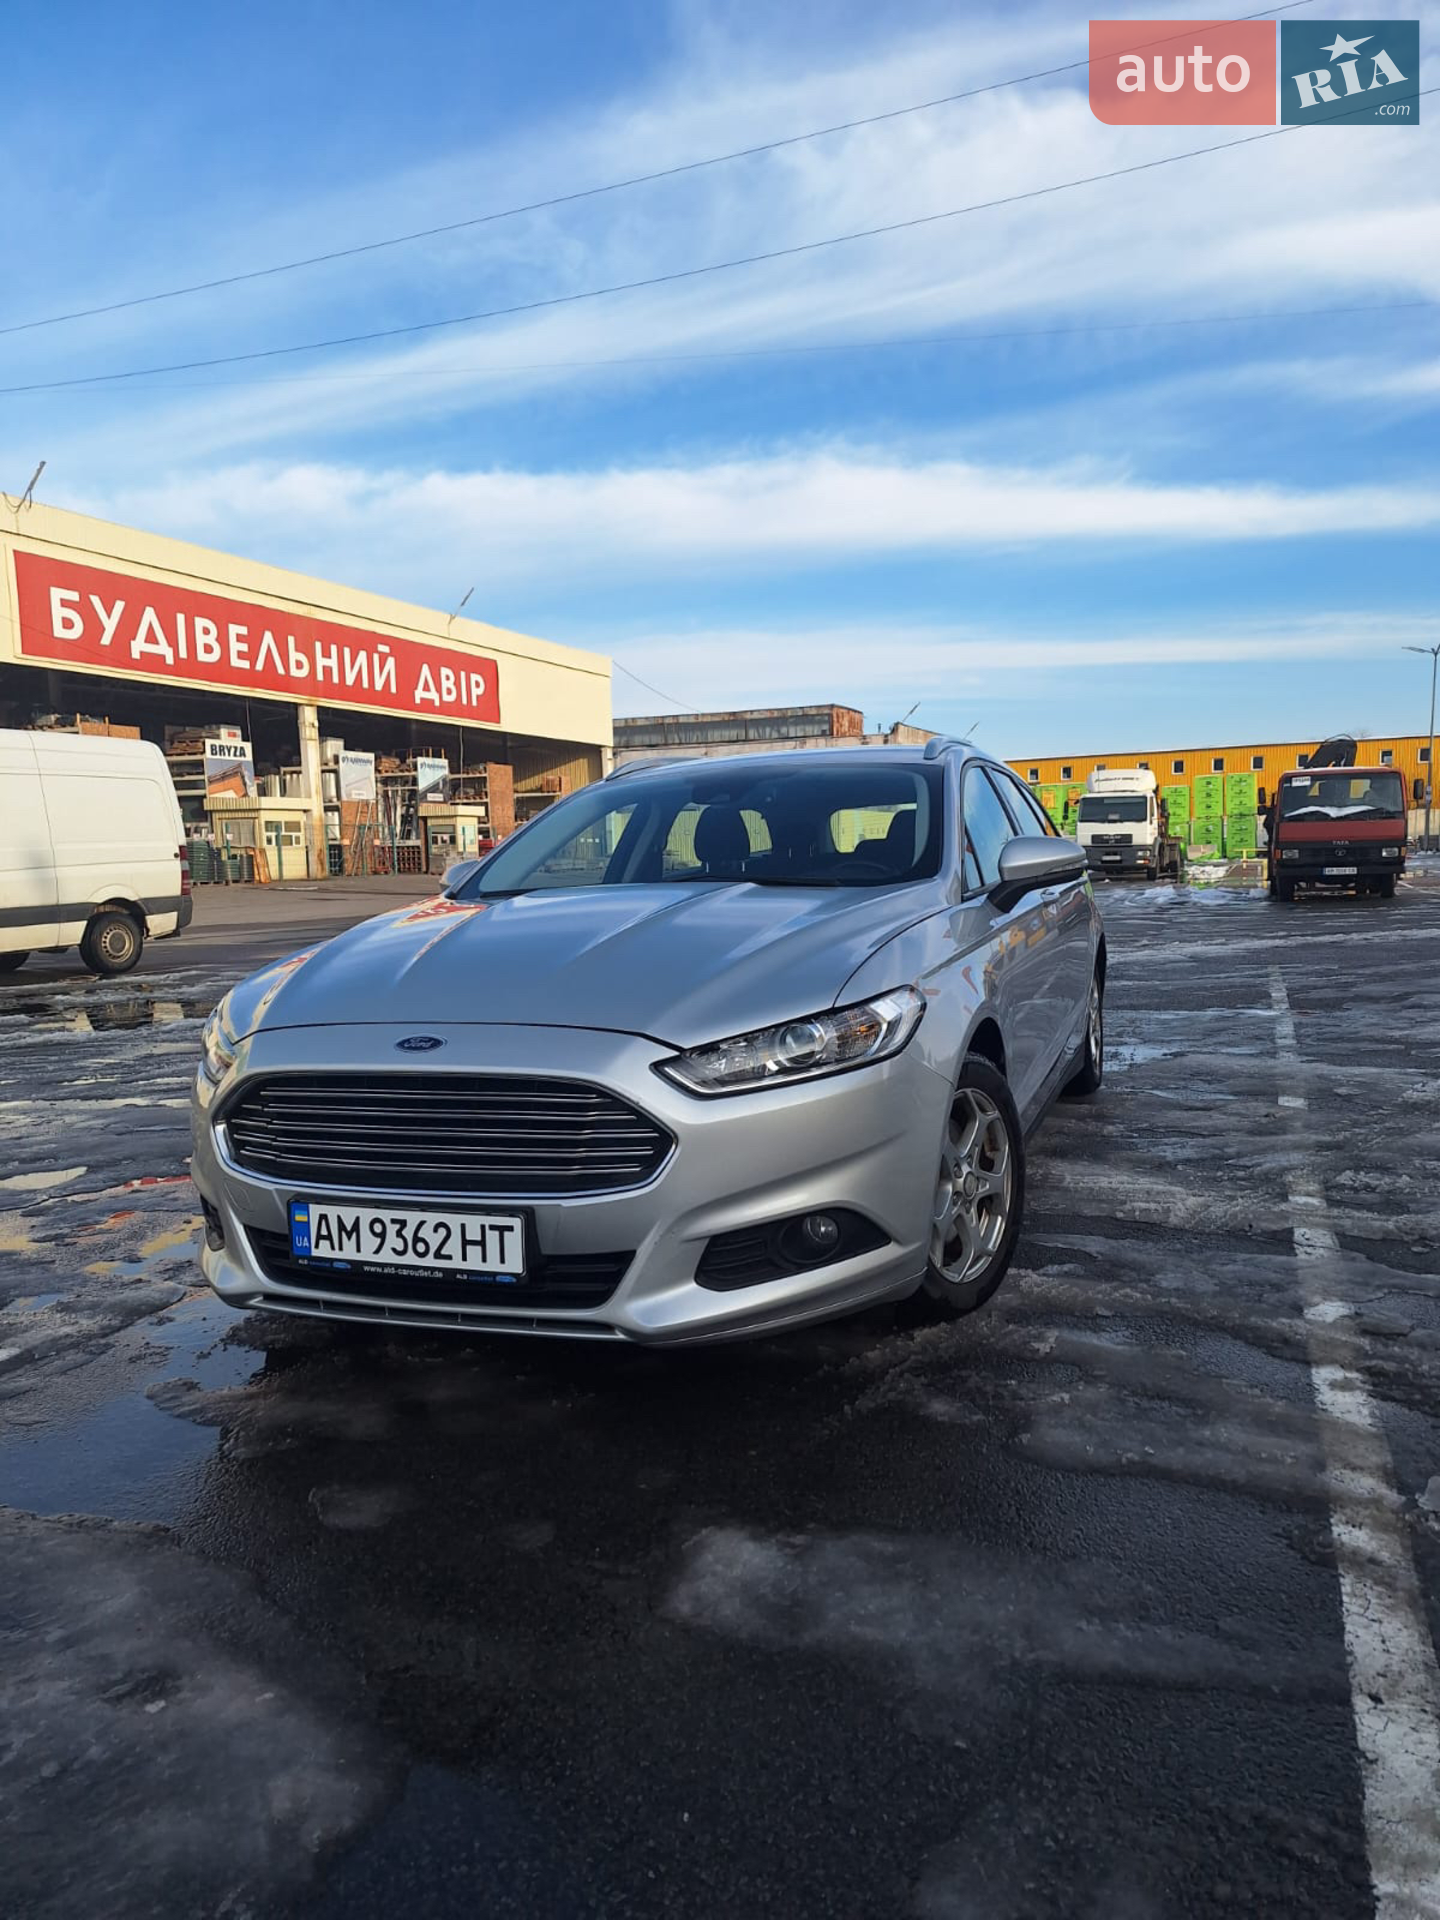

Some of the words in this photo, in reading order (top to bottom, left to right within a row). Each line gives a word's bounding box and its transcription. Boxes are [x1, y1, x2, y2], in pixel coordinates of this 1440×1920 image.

[49, 586, 397, 694] БУДІВЕЛЬНИЙ
[413, 663, 486, 707] ДВІР
[210, 743, 247, 758] BRYZA
[295, 1236, 310, 1248] UA
